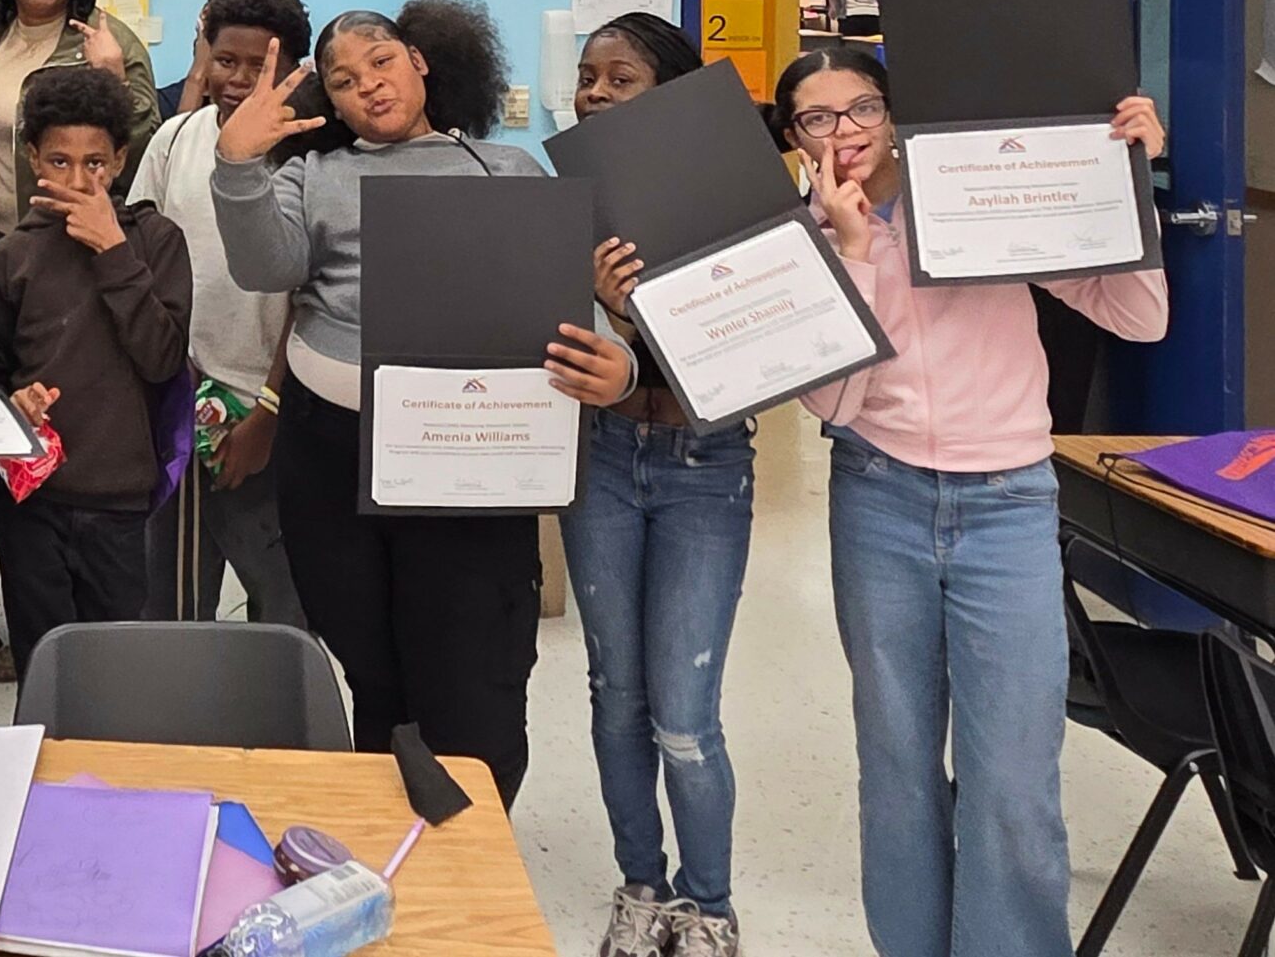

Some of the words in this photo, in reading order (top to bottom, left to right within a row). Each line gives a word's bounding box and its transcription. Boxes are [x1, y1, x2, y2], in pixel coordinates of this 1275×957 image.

[708, 15, 727, 42] 2
[938, 161, 1002, 174] Certificate
[1004, 162, 1017, 171] of
[1018, 157, 1100, 170] Achievement
[968, 194, 1019, 207] Aayliah
[1024, 191, 1079, 205] Brintley
[723, 283, 733, 295] of
[706, 316, 748, 341] Wynter
[402, 399, 462, 410] Certificate
[464, 399, 476, 410] of
[478, 399, 553, 410] Achievement
[421, 431, 471, 442] Amenia
[475, 431, 531, 442] Williams
